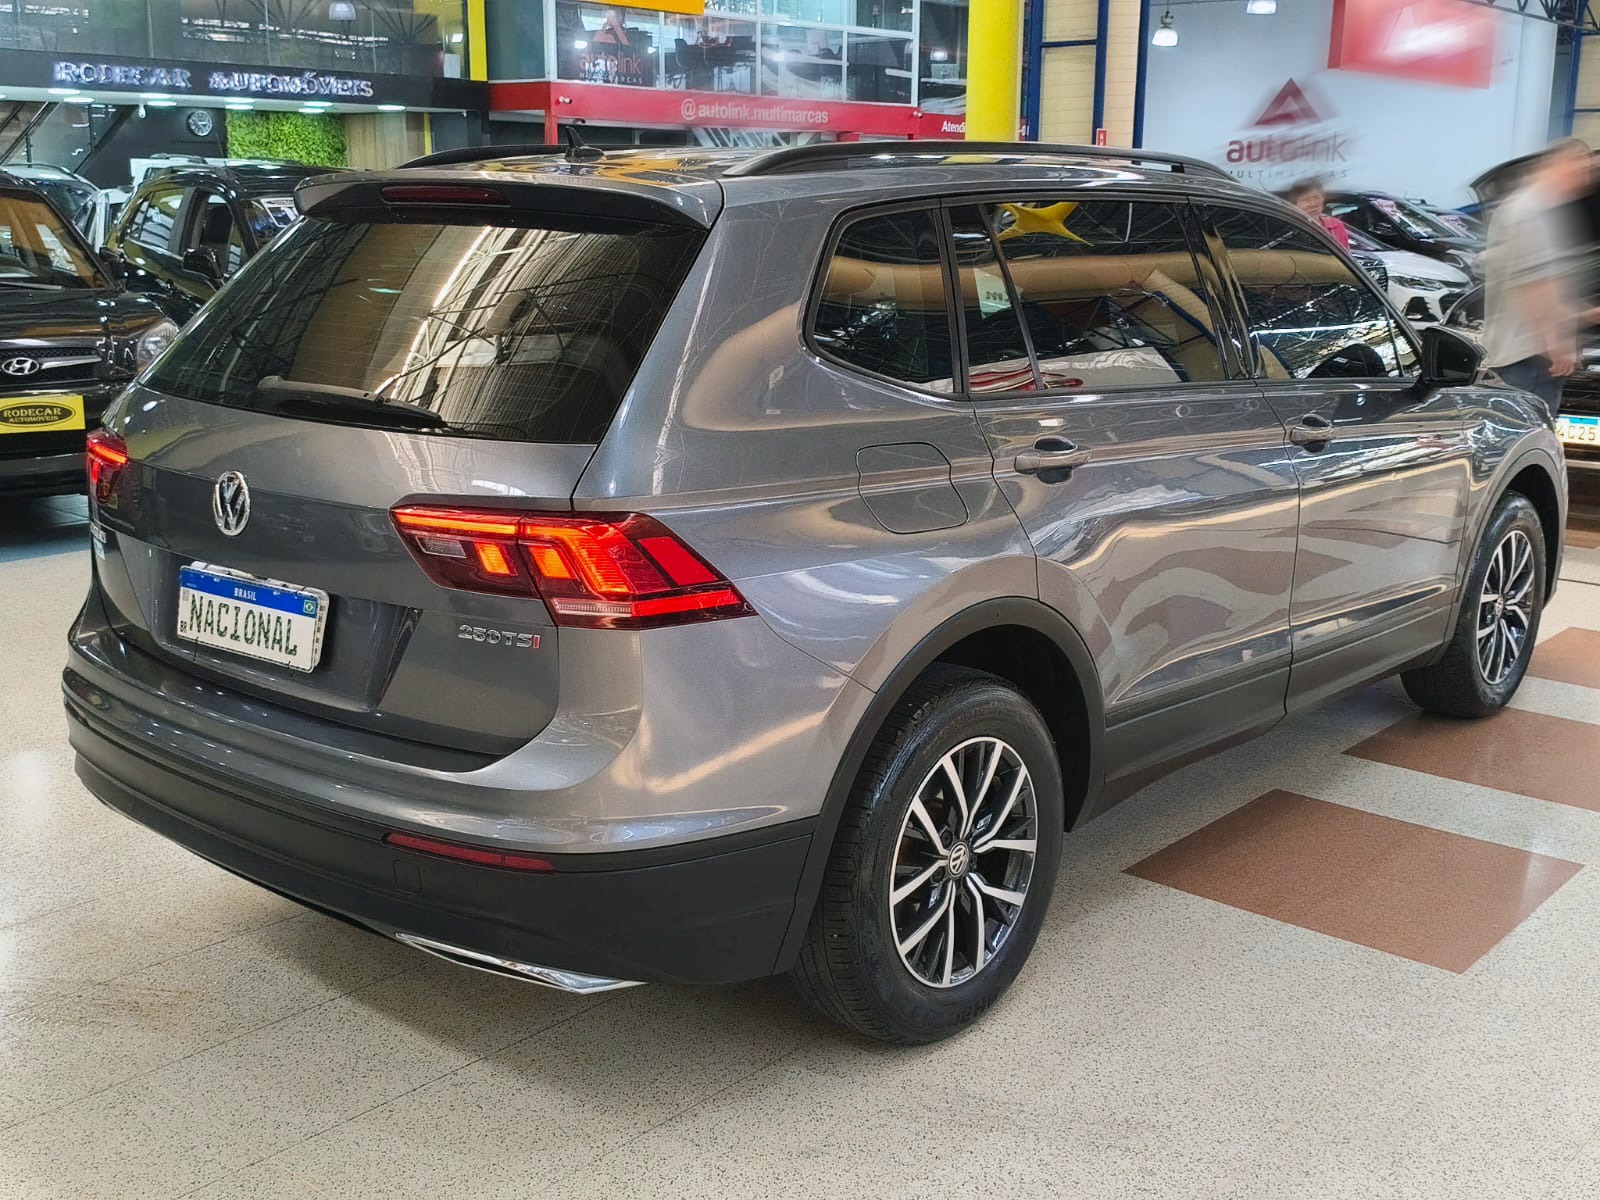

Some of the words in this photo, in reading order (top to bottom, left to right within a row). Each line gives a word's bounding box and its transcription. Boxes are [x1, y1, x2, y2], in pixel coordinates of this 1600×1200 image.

[681, 98, 829, 124] @autolink.multimarcas
[1226, 132, 1348, 163] autolink
[3, 407, 62, 418] RODECAR
[234, 587, 257, 601] BRASIL
[180, 620, 188, 634] BR
[189, 593, 298, 656] NACIONAL
